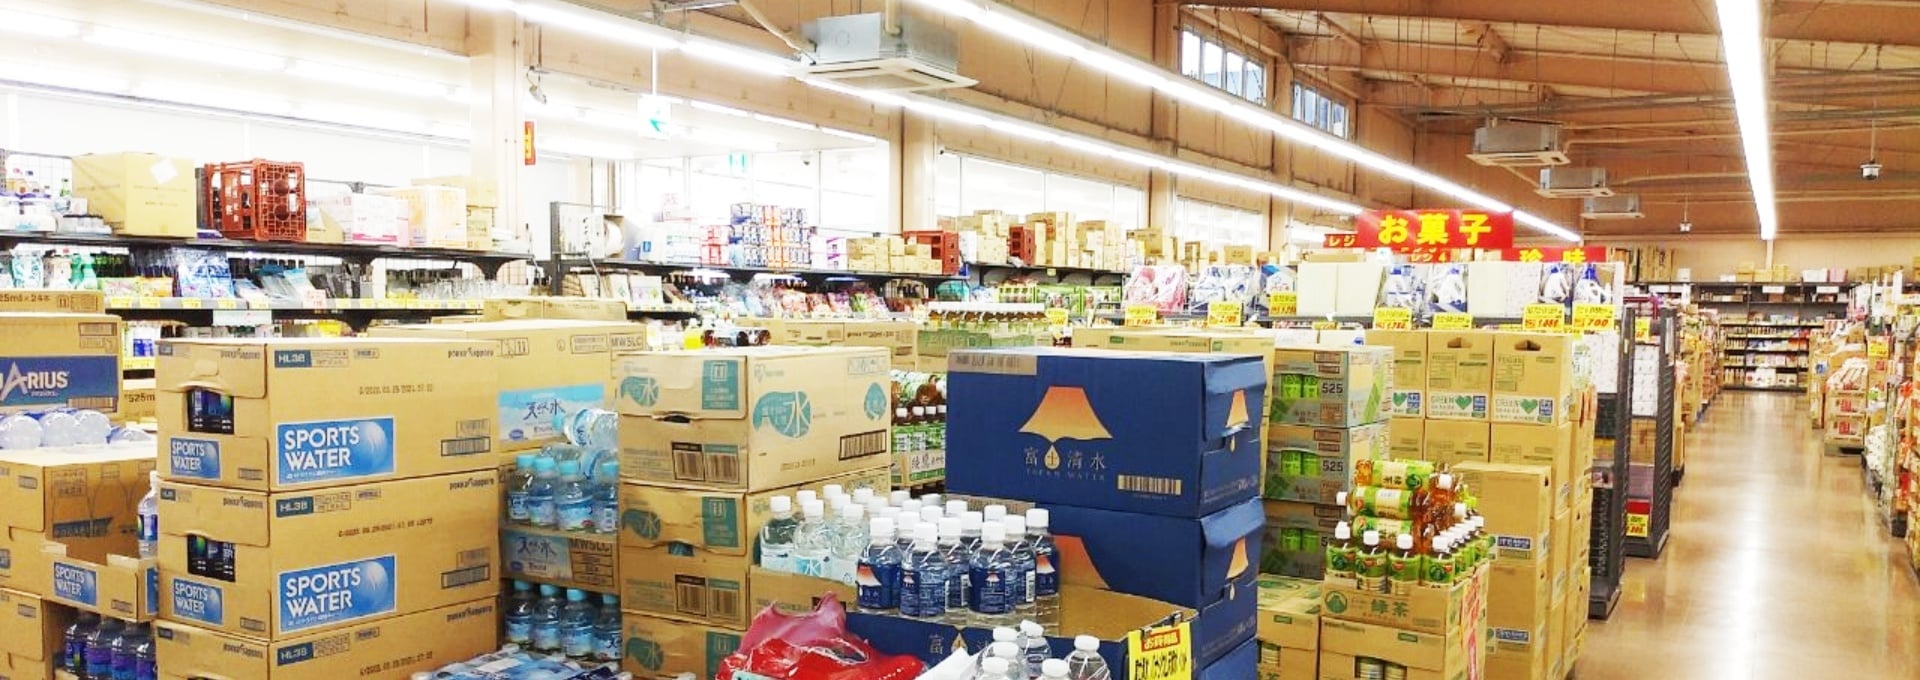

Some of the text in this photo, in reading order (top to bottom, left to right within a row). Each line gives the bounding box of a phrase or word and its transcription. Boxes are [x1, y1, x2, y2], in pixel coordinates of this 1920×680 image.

[1378, 213, 1492, 246] お菓子
[1329, 235, 1356, 247] レジ
[0, 360, 69, 402] ARIUS
[1322, 383, 1344, 394] 525
[171, 438, 205, 457] SPORTS
[285, 425, 360, 449] SPORTS
[172, 455, 202, 471] WATER
[285, 446, 351, 472] WATER
[1322, 460, 1344, 471] 525
[55, 563, 86, 584] SPORTS
[286, 567, 361, 598] SPORTS
[56, 578, 82, 597] WATER
[174, 579, 209, 600] SPORTS
[174, 595, 206, 614] WATER
[286, 590, 353, 617] WATER
